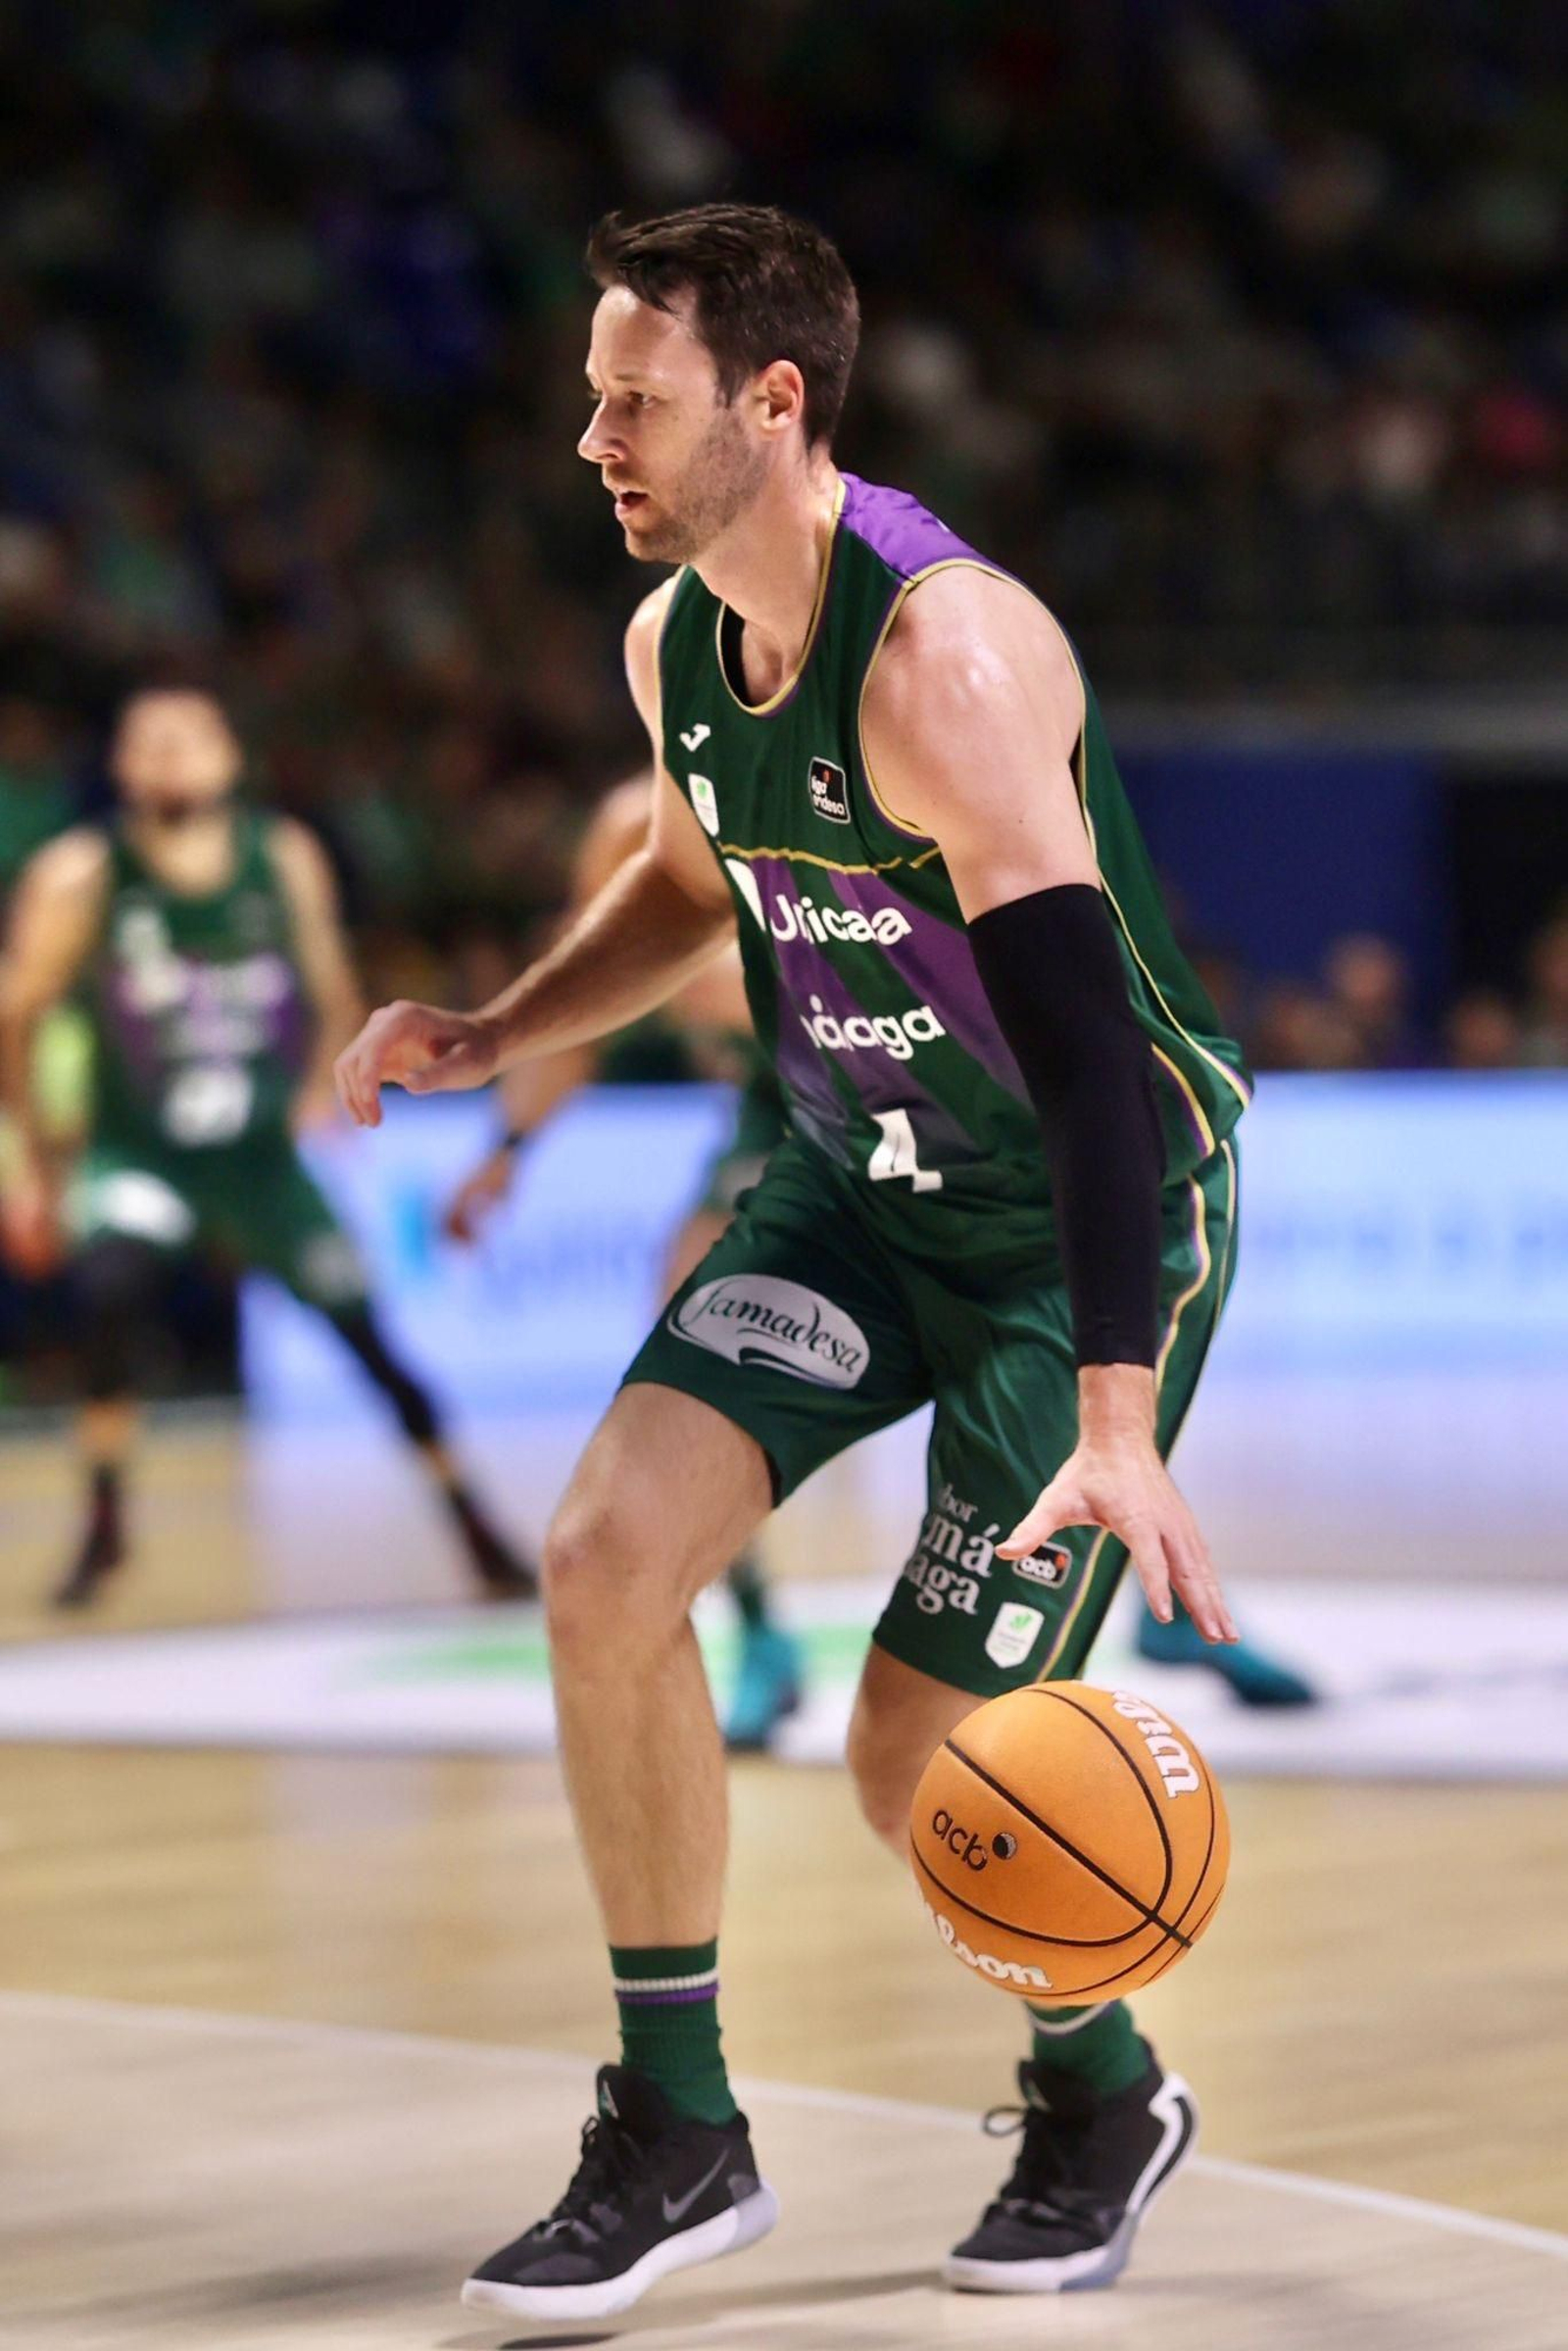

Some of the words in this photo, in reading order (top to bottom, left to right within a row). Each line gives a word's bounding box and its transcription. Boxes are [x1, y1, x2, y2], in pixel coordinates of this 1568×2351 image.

[868, 1108, 943, 1193] 4
[905, 1553, 980, 1614] aga
[932, 1809, 989, 1872] acb
[924, 1899, 1054, 1989] lson
